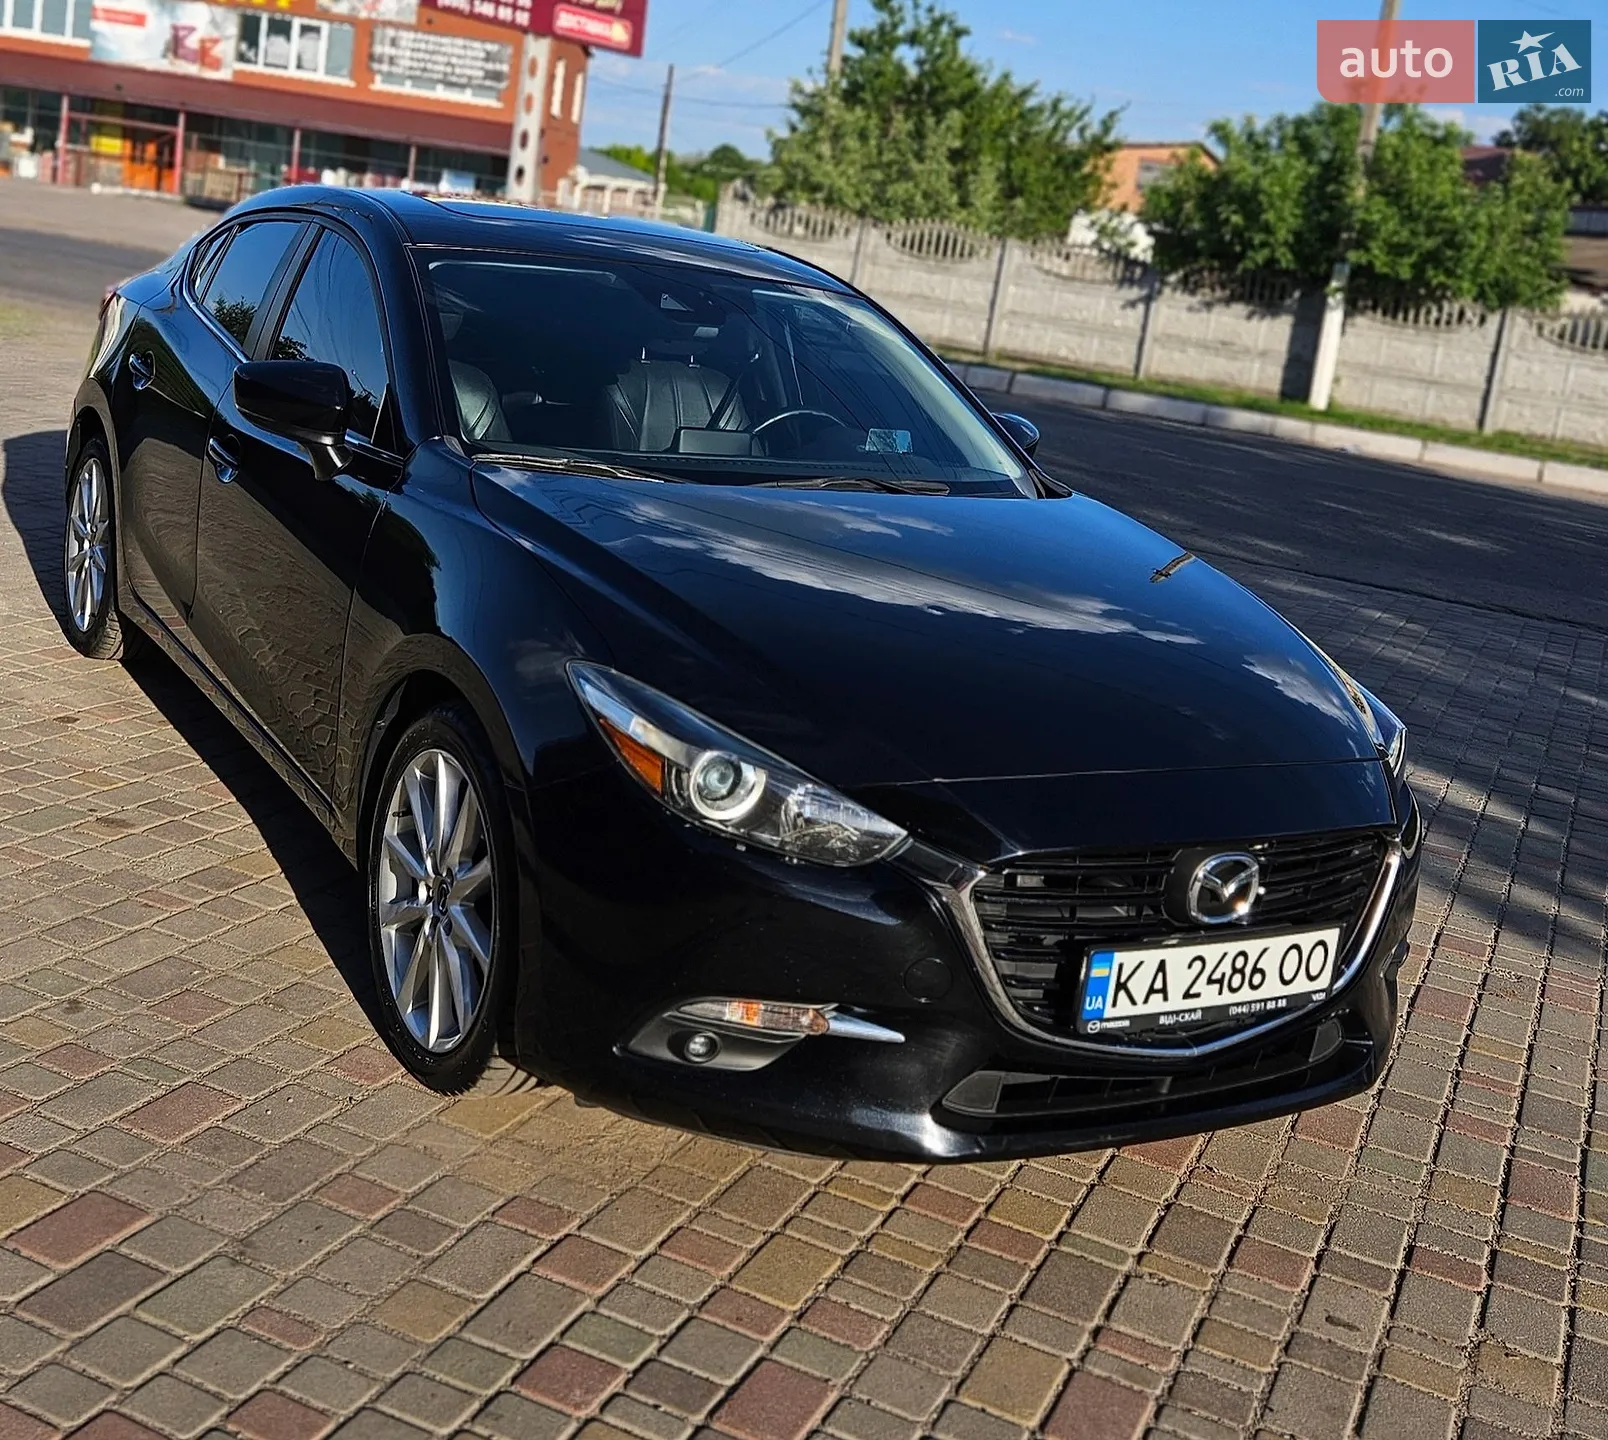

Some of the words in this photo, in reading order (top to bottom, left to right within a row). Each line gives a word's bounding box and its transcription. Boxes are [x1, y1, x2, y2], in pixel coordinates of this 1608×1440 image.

[1085, 995, 1104, 1011] UA
[1111, 958, 1169, 1008] KA
[1182, 946, 1270, 1000] 2486
[1229, 1003, 1249, 1016] (044)
[1250, 1001, 1265, 1013] 591
